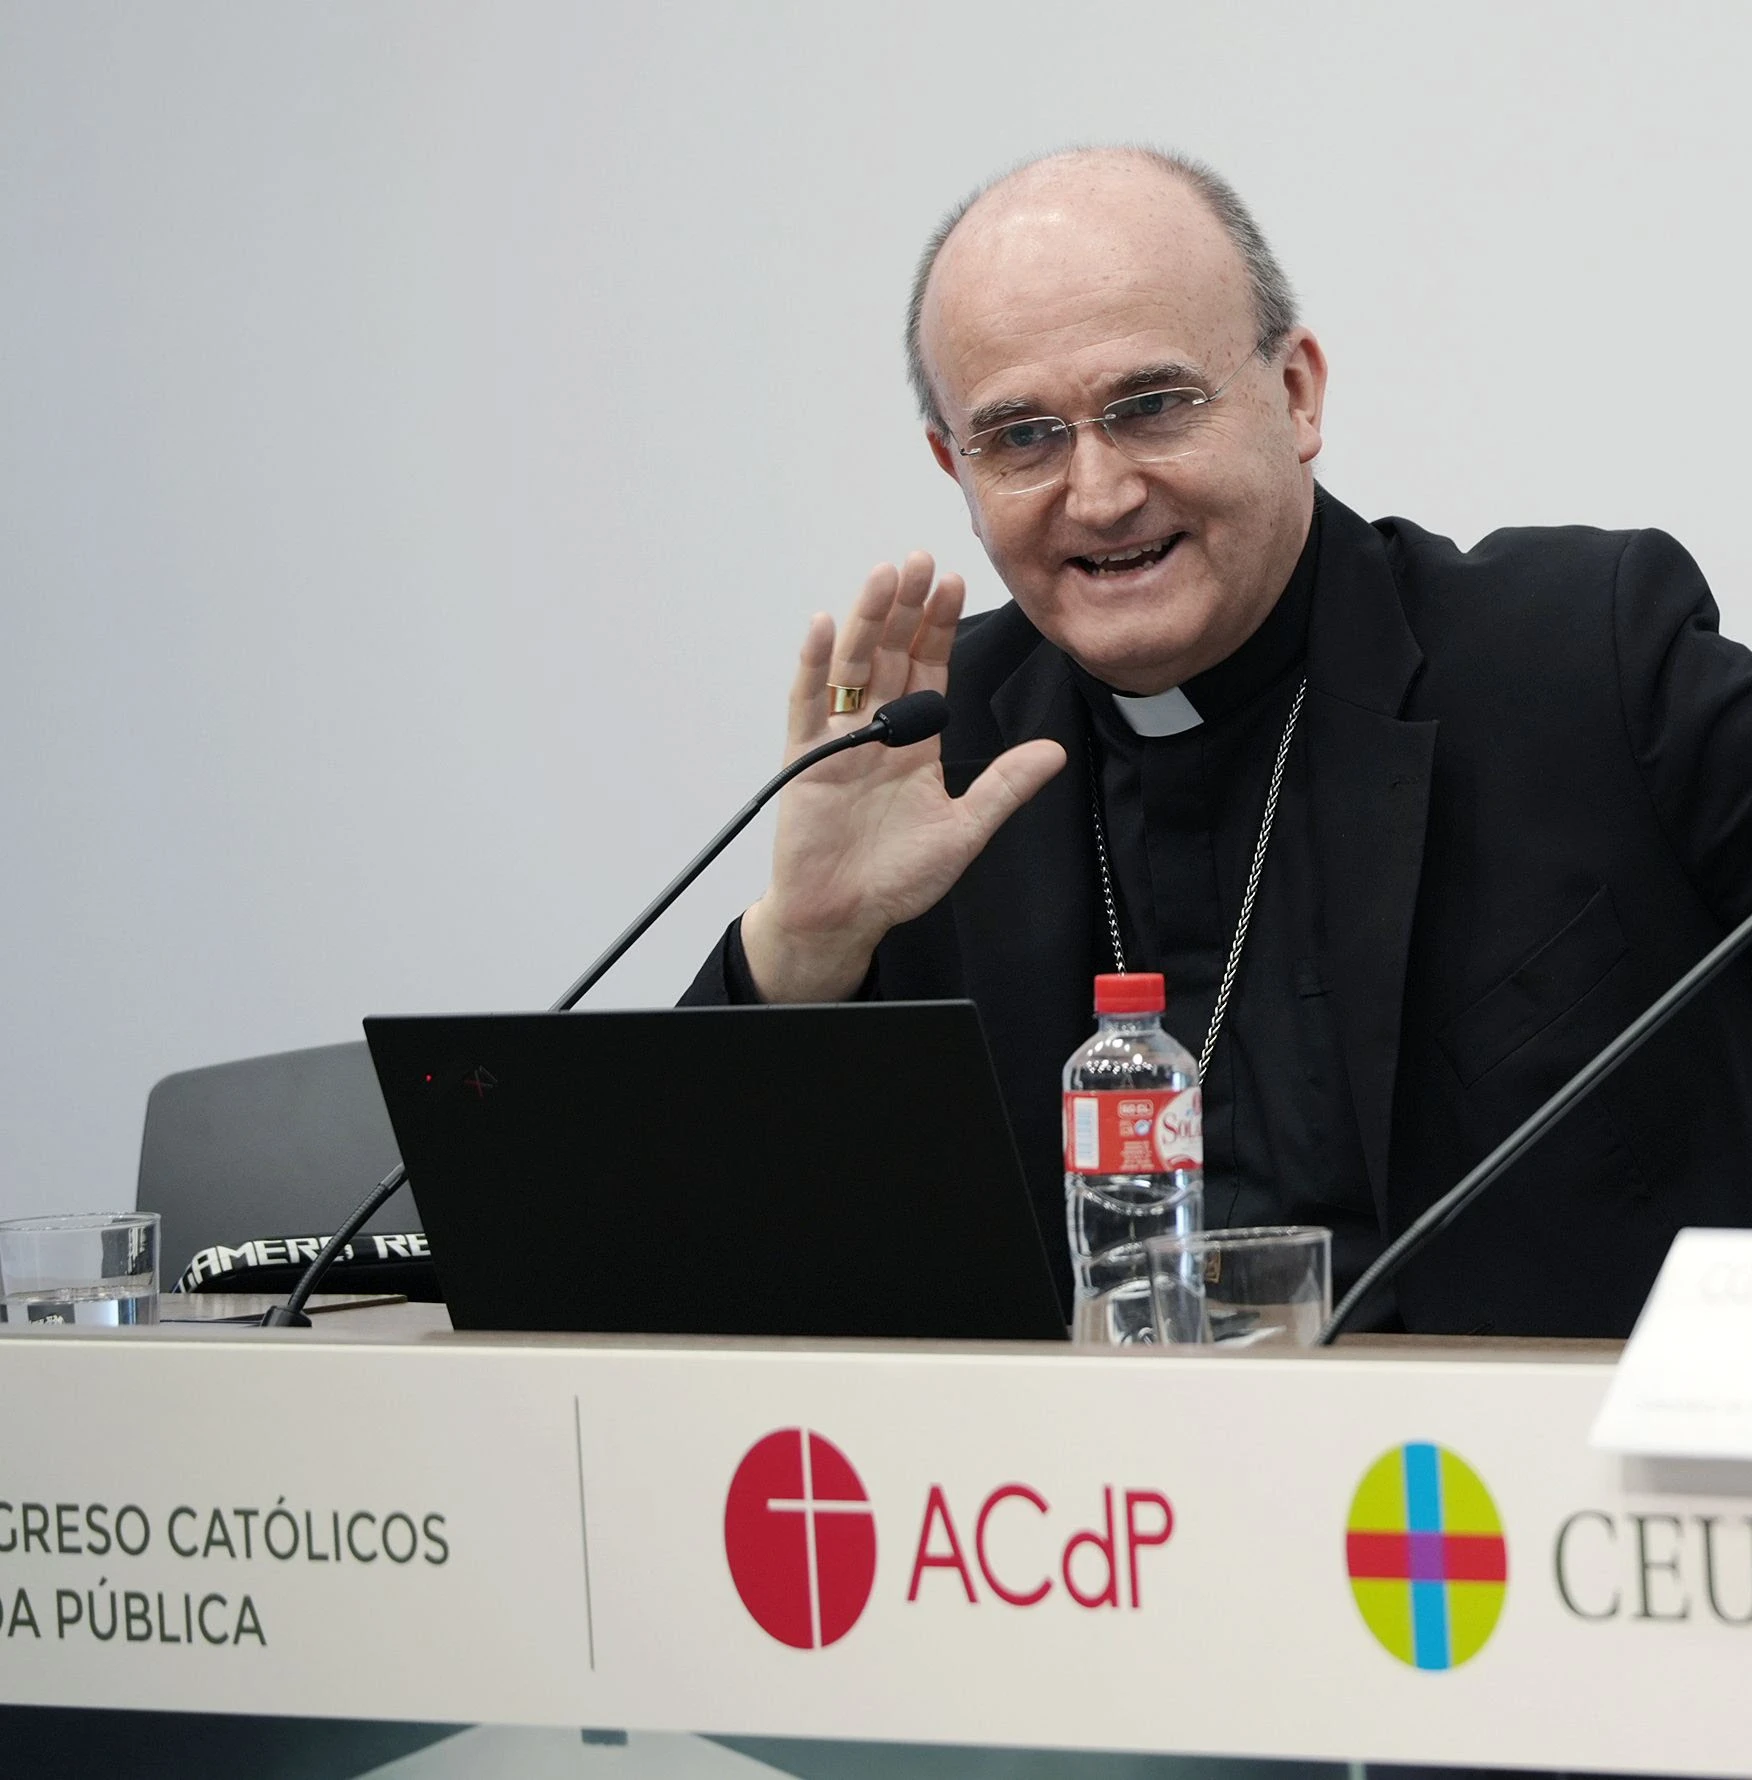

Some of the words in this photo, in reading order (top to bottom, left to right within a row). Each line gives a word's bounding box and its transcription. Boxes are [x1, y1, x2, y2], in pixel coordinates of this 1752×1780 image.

[168, 1496, 449, 1566] CATÓLICOS
[907, 1483, 1176, 1610] ACdP
[0, 1587, 42, 1639] A
[55, 1576, 268, 1647] PÚBLICA
